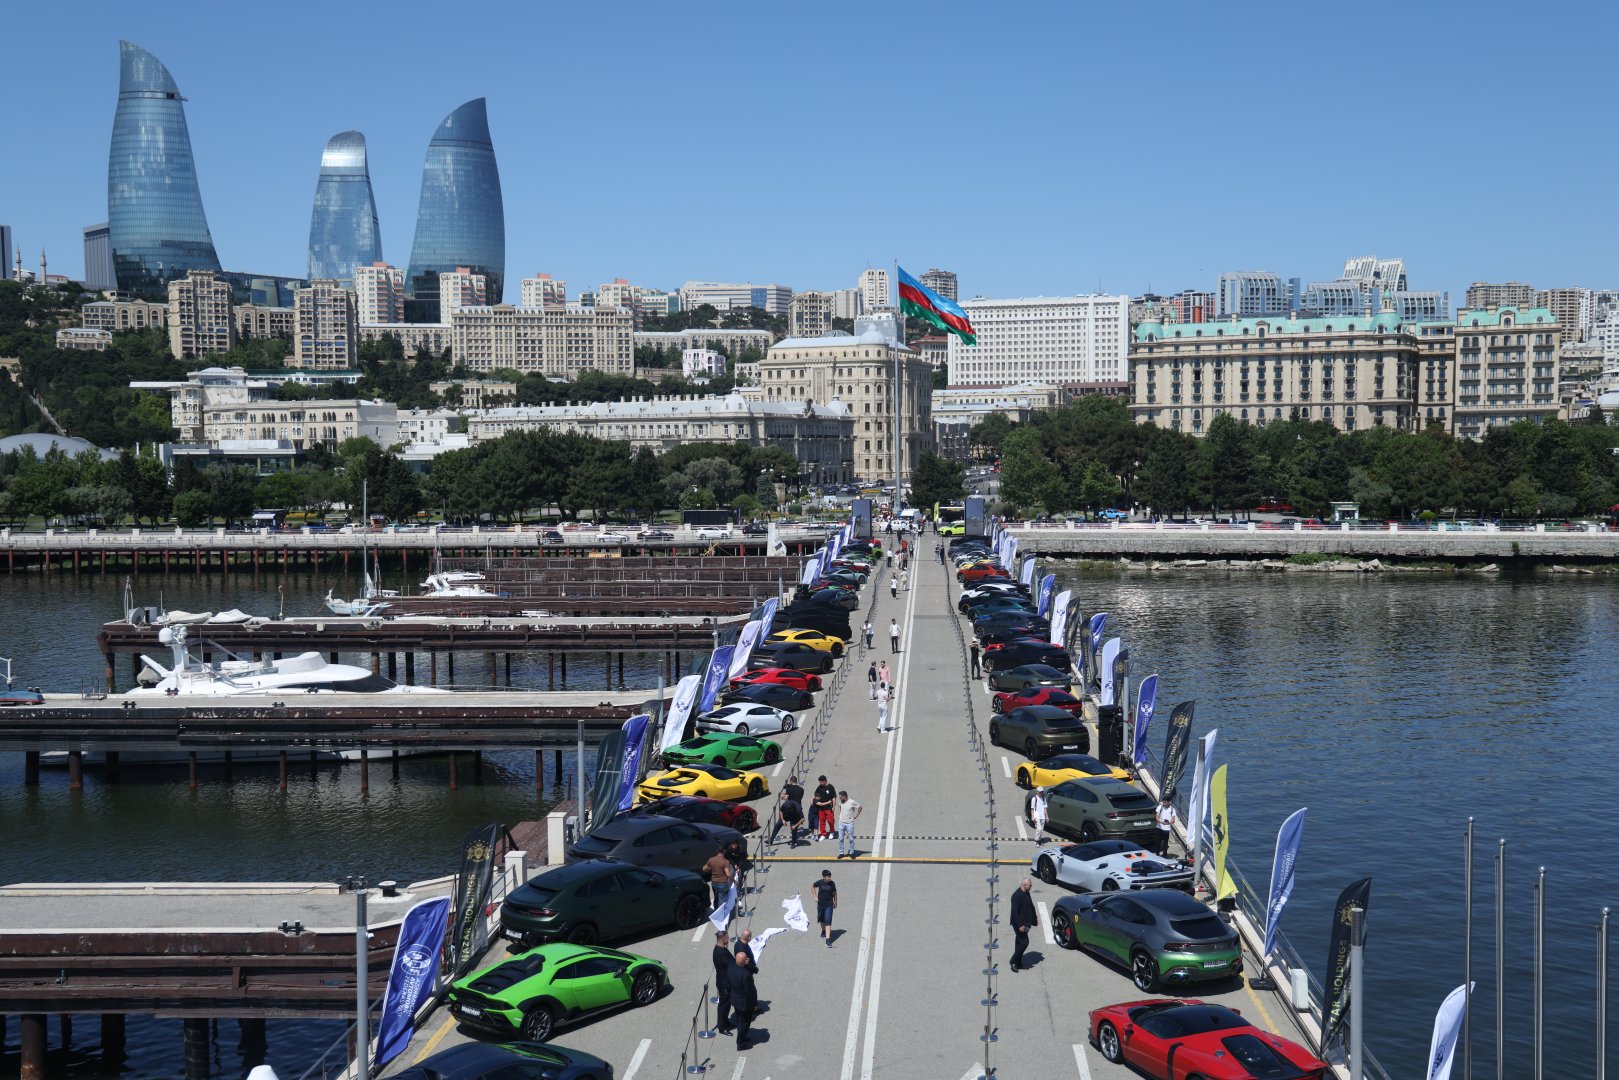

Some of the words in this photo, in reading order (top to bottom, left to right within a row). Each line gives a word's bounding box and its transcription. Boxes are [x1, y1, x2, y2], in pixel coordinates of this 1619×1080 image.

[464, 874, 476, 923] HOLDINGS
[461, 927, 472, 962] NAZAR
[1333, 939, 1347, 995] HOLDINGS
